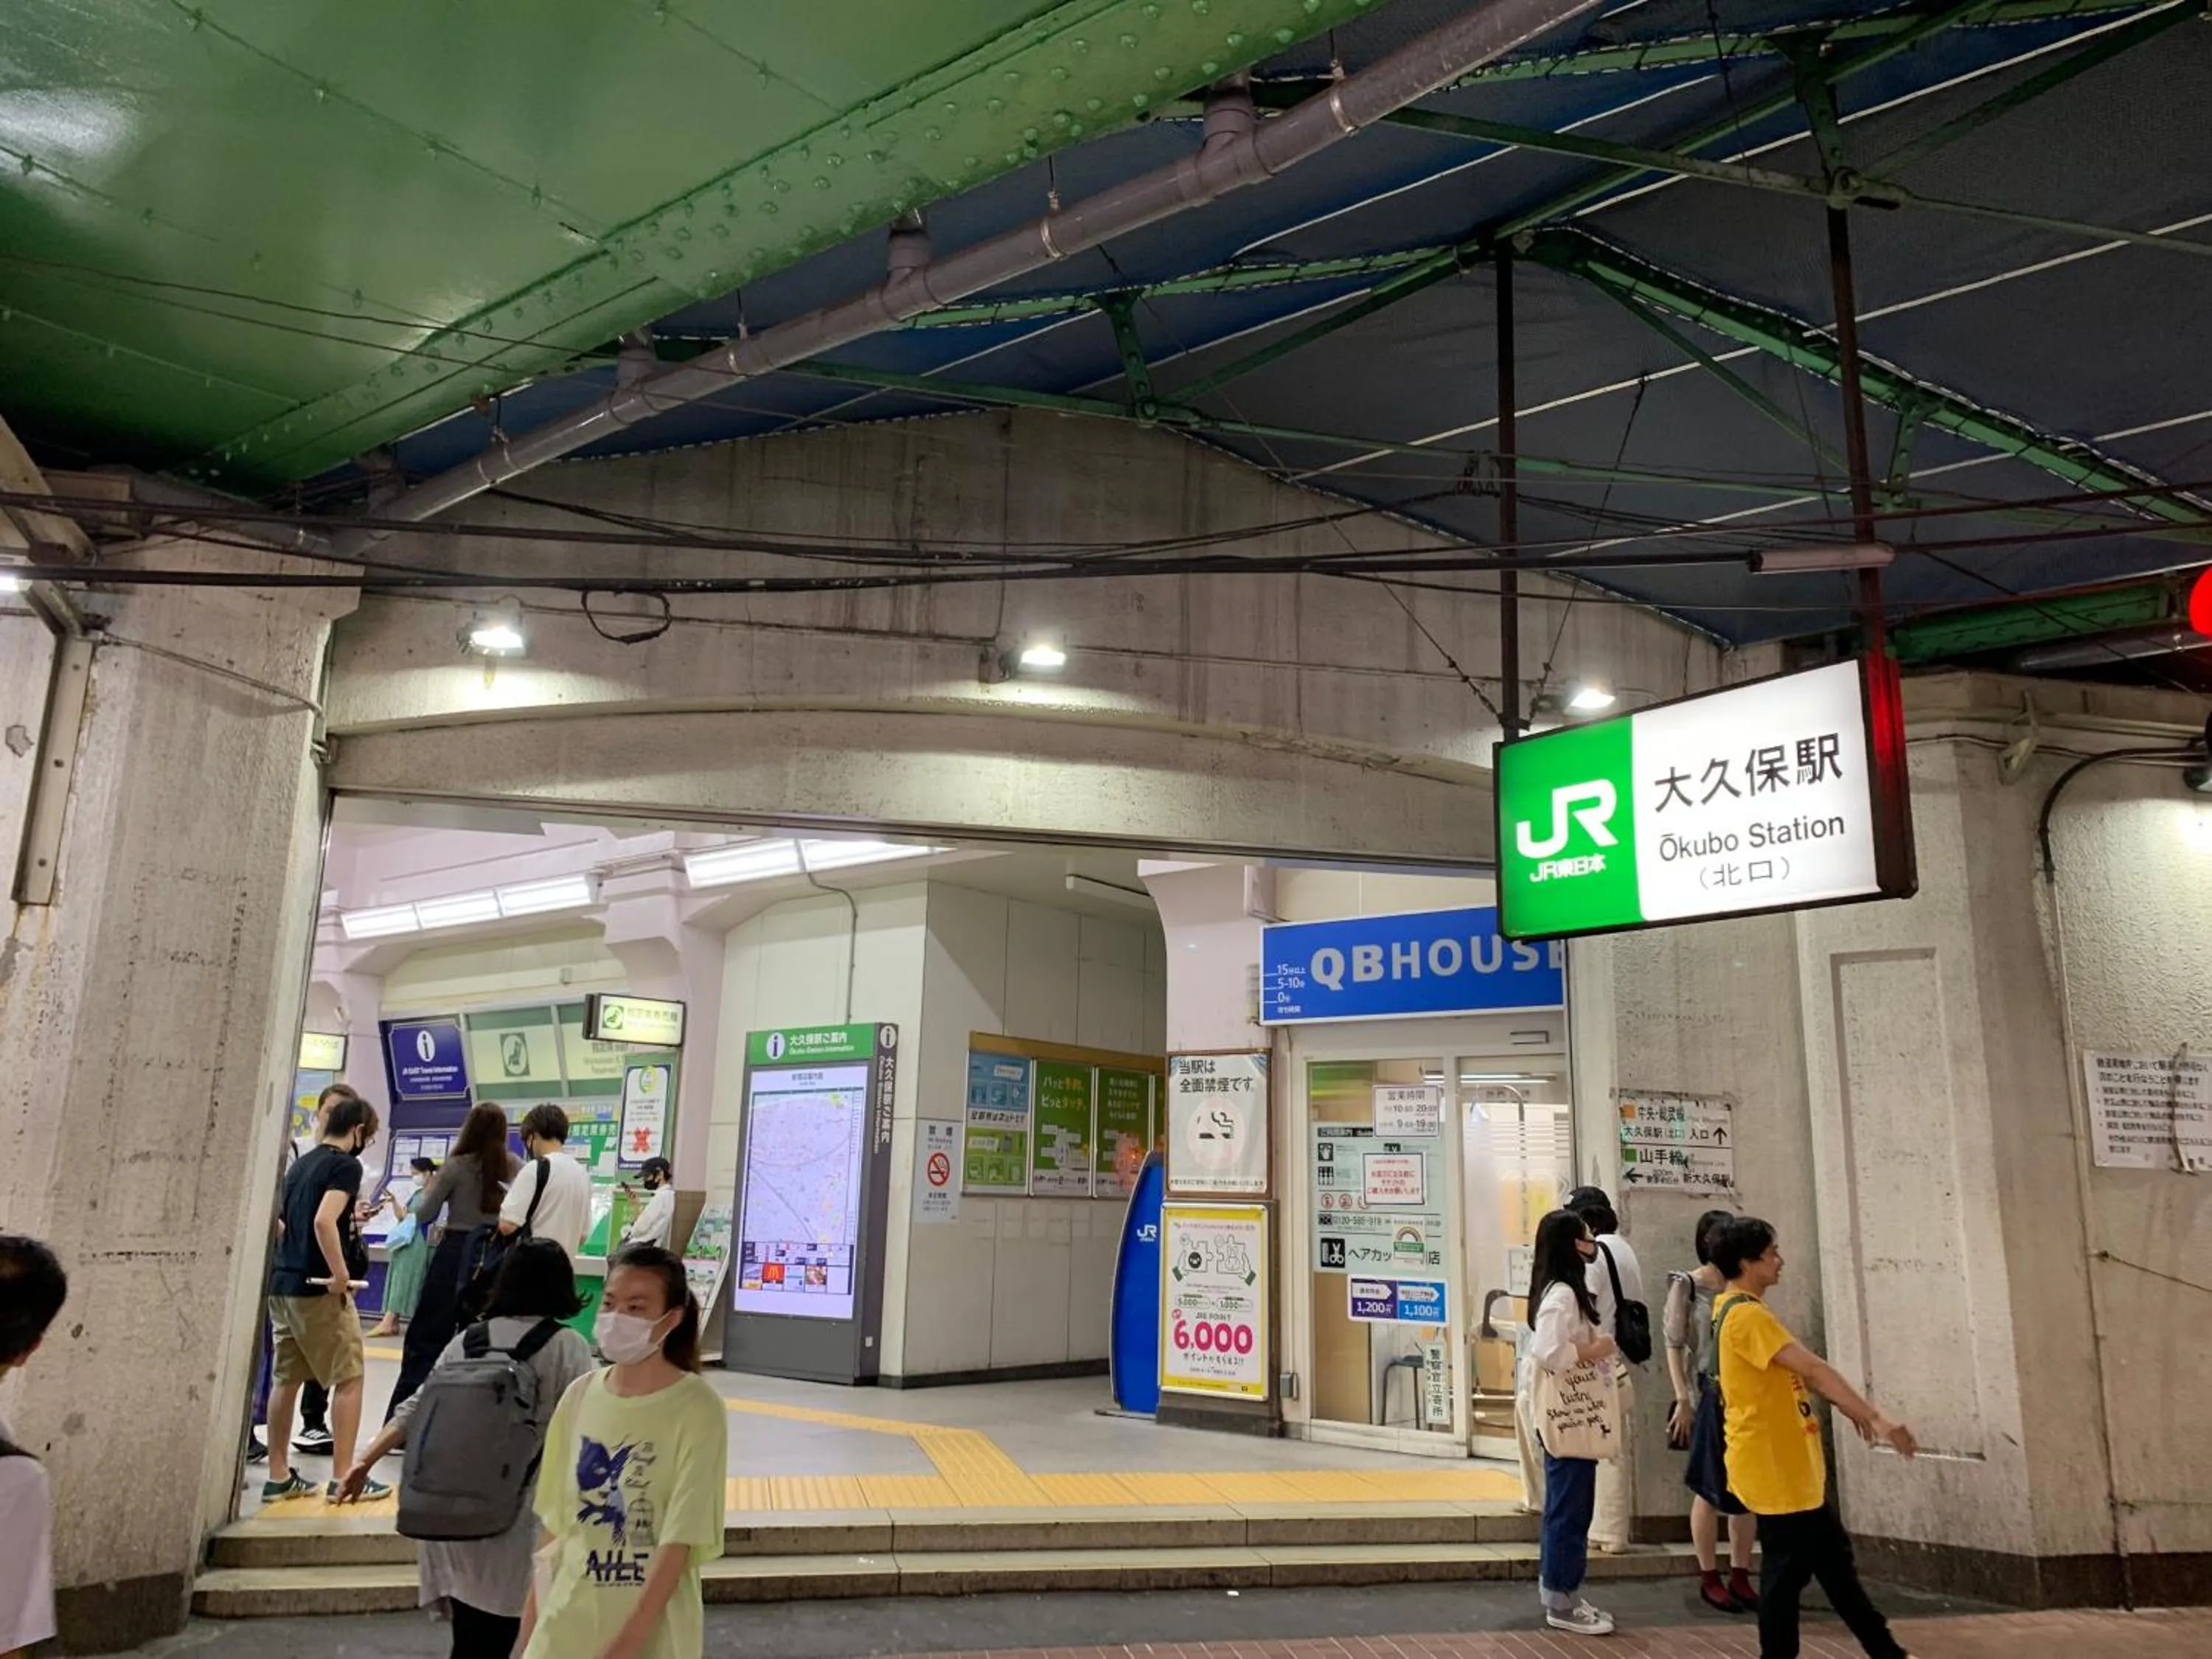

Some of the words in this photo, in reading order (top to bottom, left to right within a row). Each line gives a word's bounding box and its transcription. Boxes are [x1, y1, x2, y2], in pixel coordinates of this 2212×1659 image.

[1654, 732, 1843, 813] 大久保駅
[1515, 779, 1618, 859] JR
[1659, 832, 1739, 862] Ōkubo
[1748, 813, 1845, 849] Station
[1529, 854, 1607, 883] JR東日本
[1180, 1060, 1216, 1074] 当駅は
[1136, 1225, 1157, 1238] JR
[1173, 1320, 1253, 1354] 6,000
